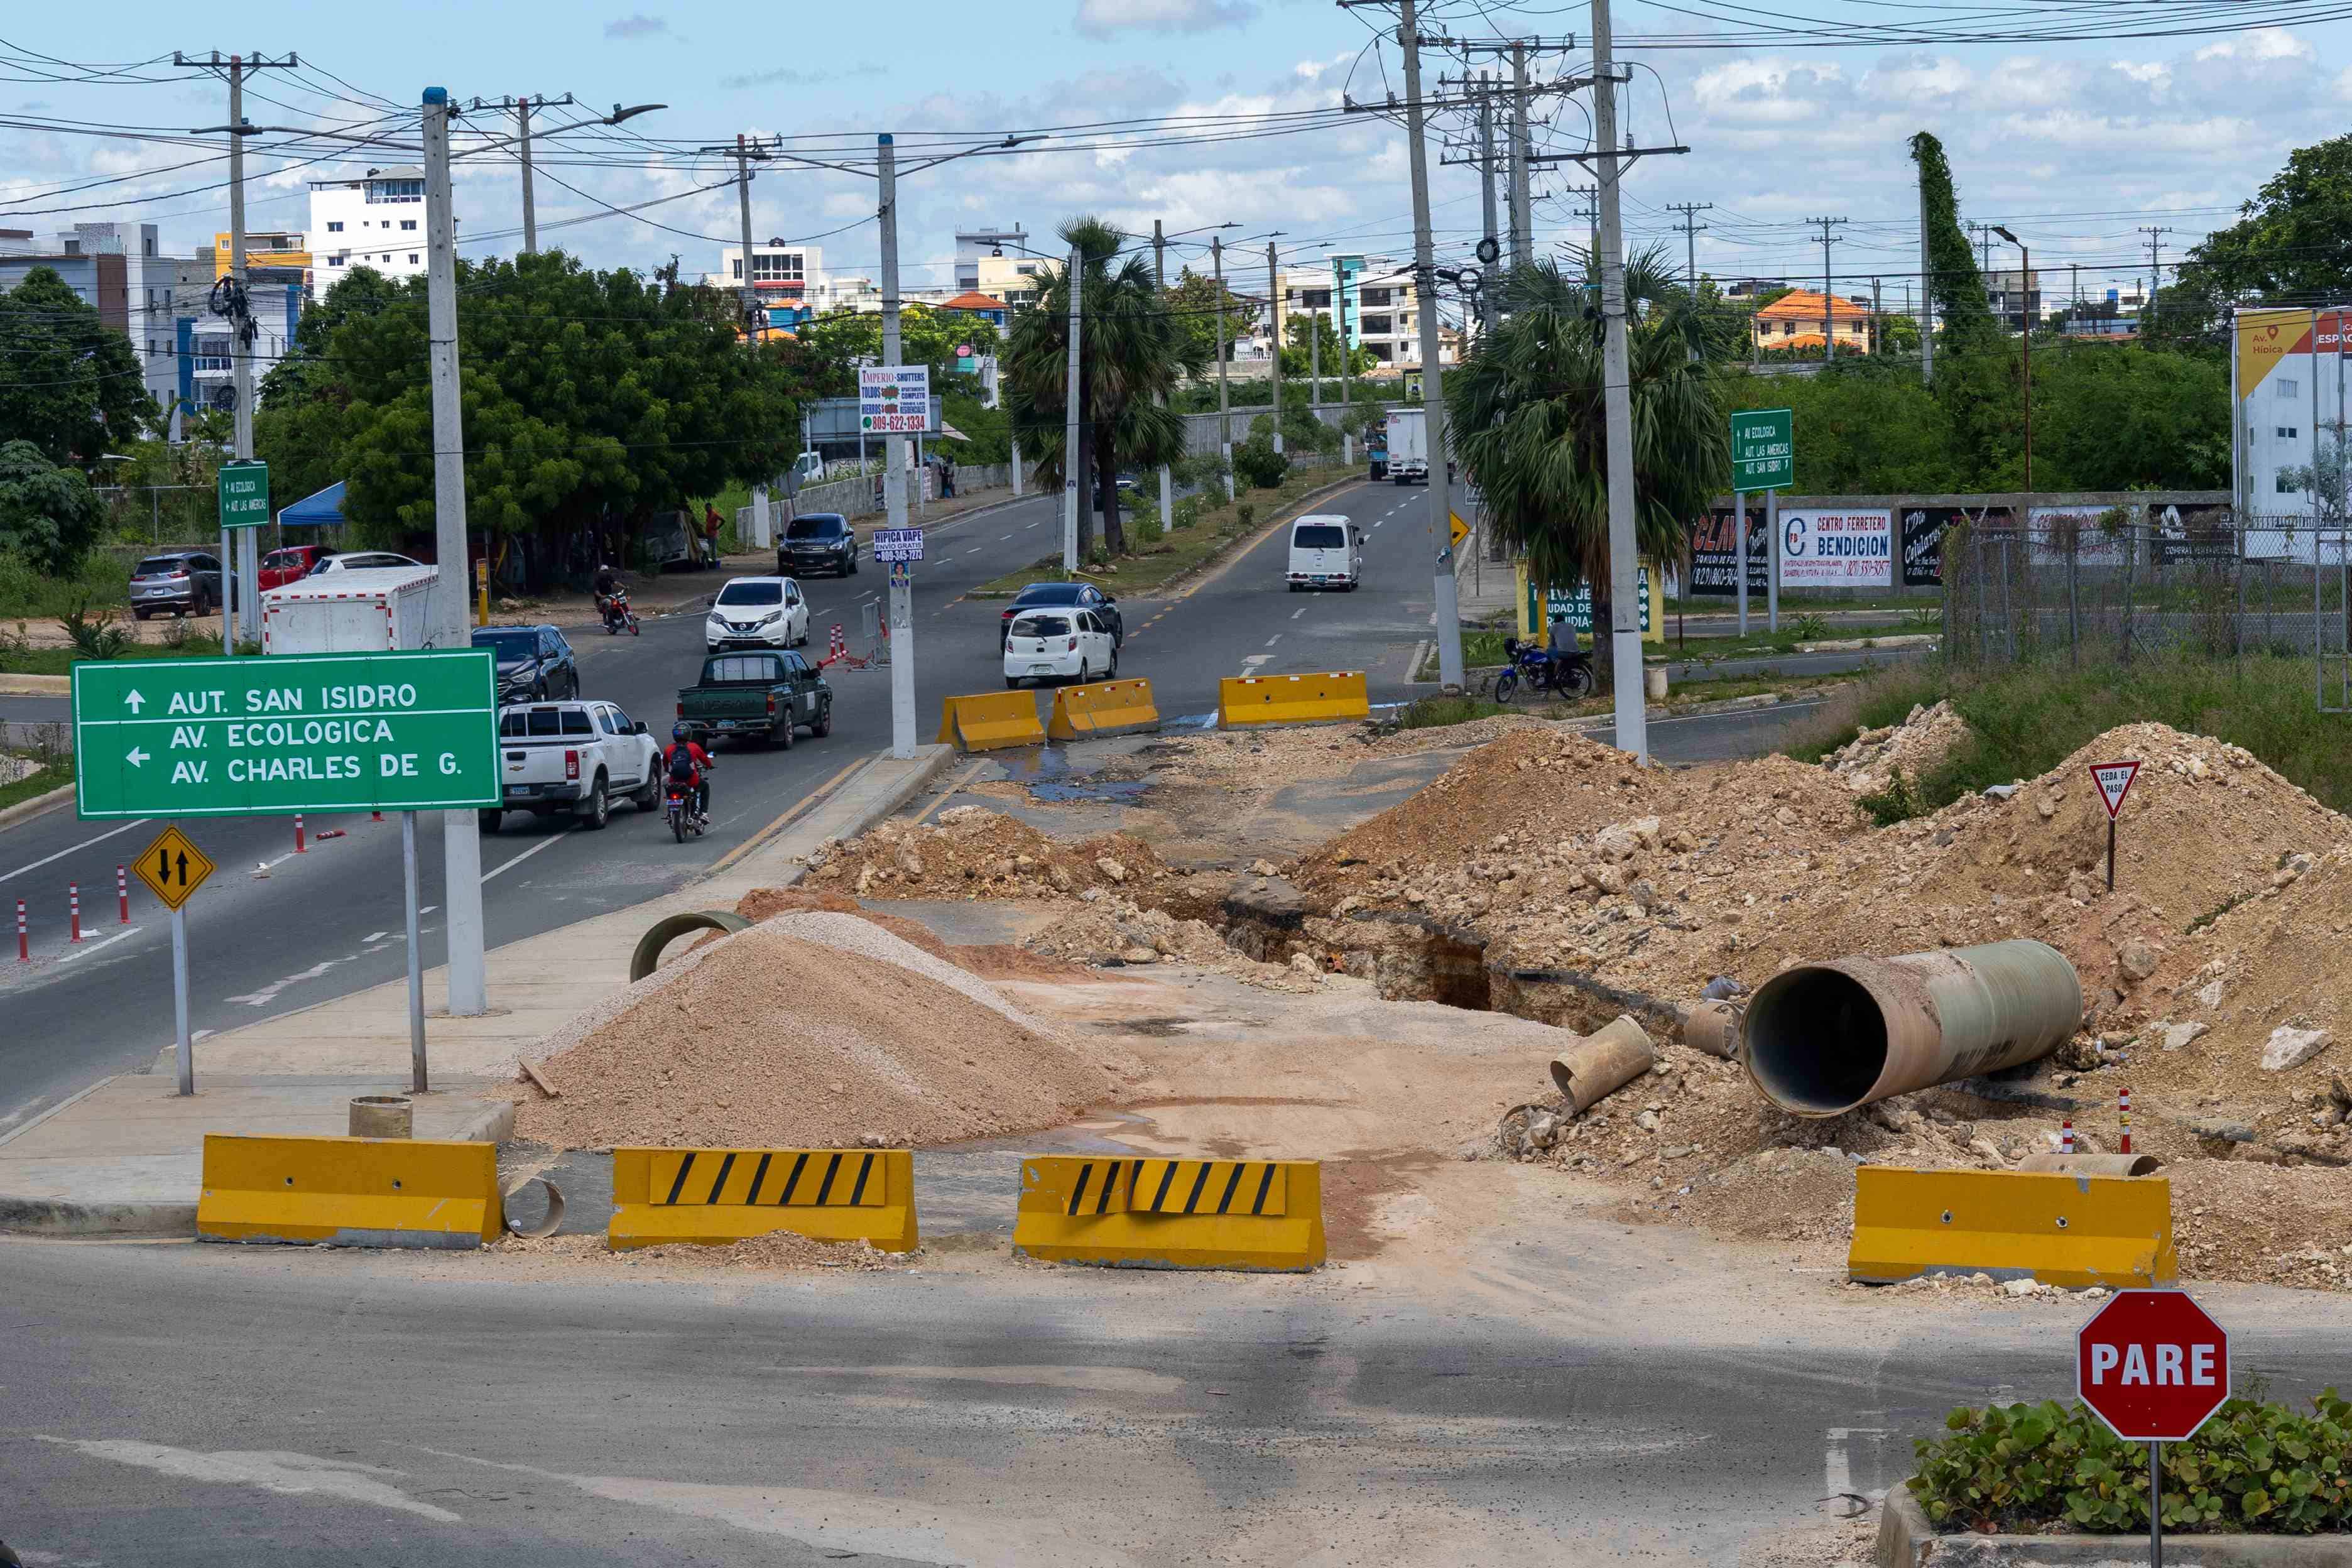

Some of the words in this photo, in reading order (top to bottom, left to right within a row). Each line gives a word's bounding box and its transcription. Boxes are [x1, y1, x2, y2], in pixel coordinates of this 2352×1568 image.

[862, 372, 894, 383] IMPERIO
[861, 386, 881, 398] TOLDOS
[1751, 425, 1777, 438] ECOLOGICA
[1756, 445, 1765, 457] LAS
[1767, 442, 1789, 455] AMERICAS
[1757, 462, 1766, 473] SAN
[1767, 459, 1782, 472] ISIDRO
[1817, 516, 1843, 531] CENTRO
[1846, 516, 1886, 531] FERRETERO
[874, 531, 901, 543] HIPICA
[903, 530, 922, 542] VAPE
[1817, 536, 1889, 557] BENDICION
[168, 690, 228, 714] AUT.
[246, 688, 303, 712] SAN
[322, 683, 417, 709] ISIDRO
[170, 726, 208, 749] AV.
[227, 719, 395, 747] ECOLOGICA
[171, 761, 209, 784] AV.
[227, 756, 361, 782] CHARLES
[380, 753, 418, 776] DE
[439, 752, 462, 775] G.
[2101, 771, 2117, 781] CEDA
[2121, 770, 2128, 780] EL
[2106, 784, 2122, 793] PASO
[2091, 1344, 2216, 1386] PARE
